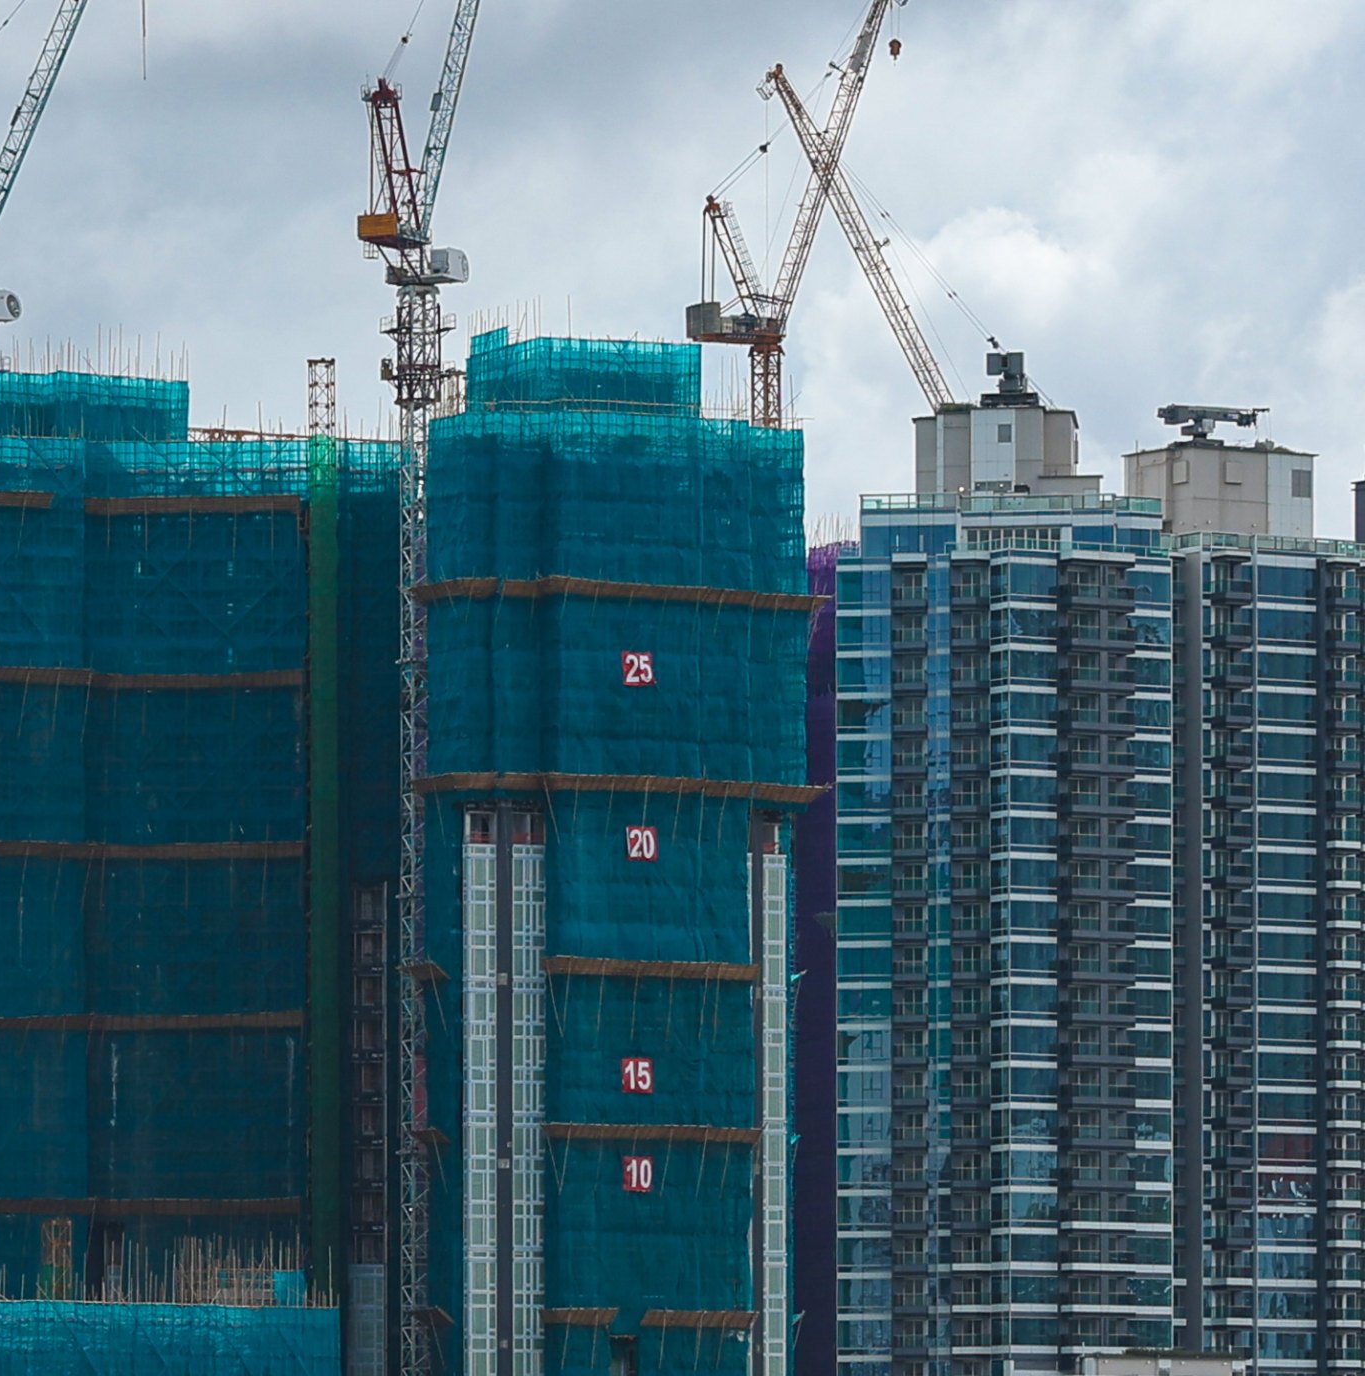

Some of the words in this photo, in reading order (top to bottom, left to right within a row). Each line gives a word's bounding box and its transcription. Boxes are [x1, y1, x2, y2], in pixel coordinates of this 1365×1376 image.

[625, 654, 653, 683] 25
[629, 828, 656, 858] 20
[624, 1061, 651, 1090] 15
[626, 1159, 652, 1188] 10
